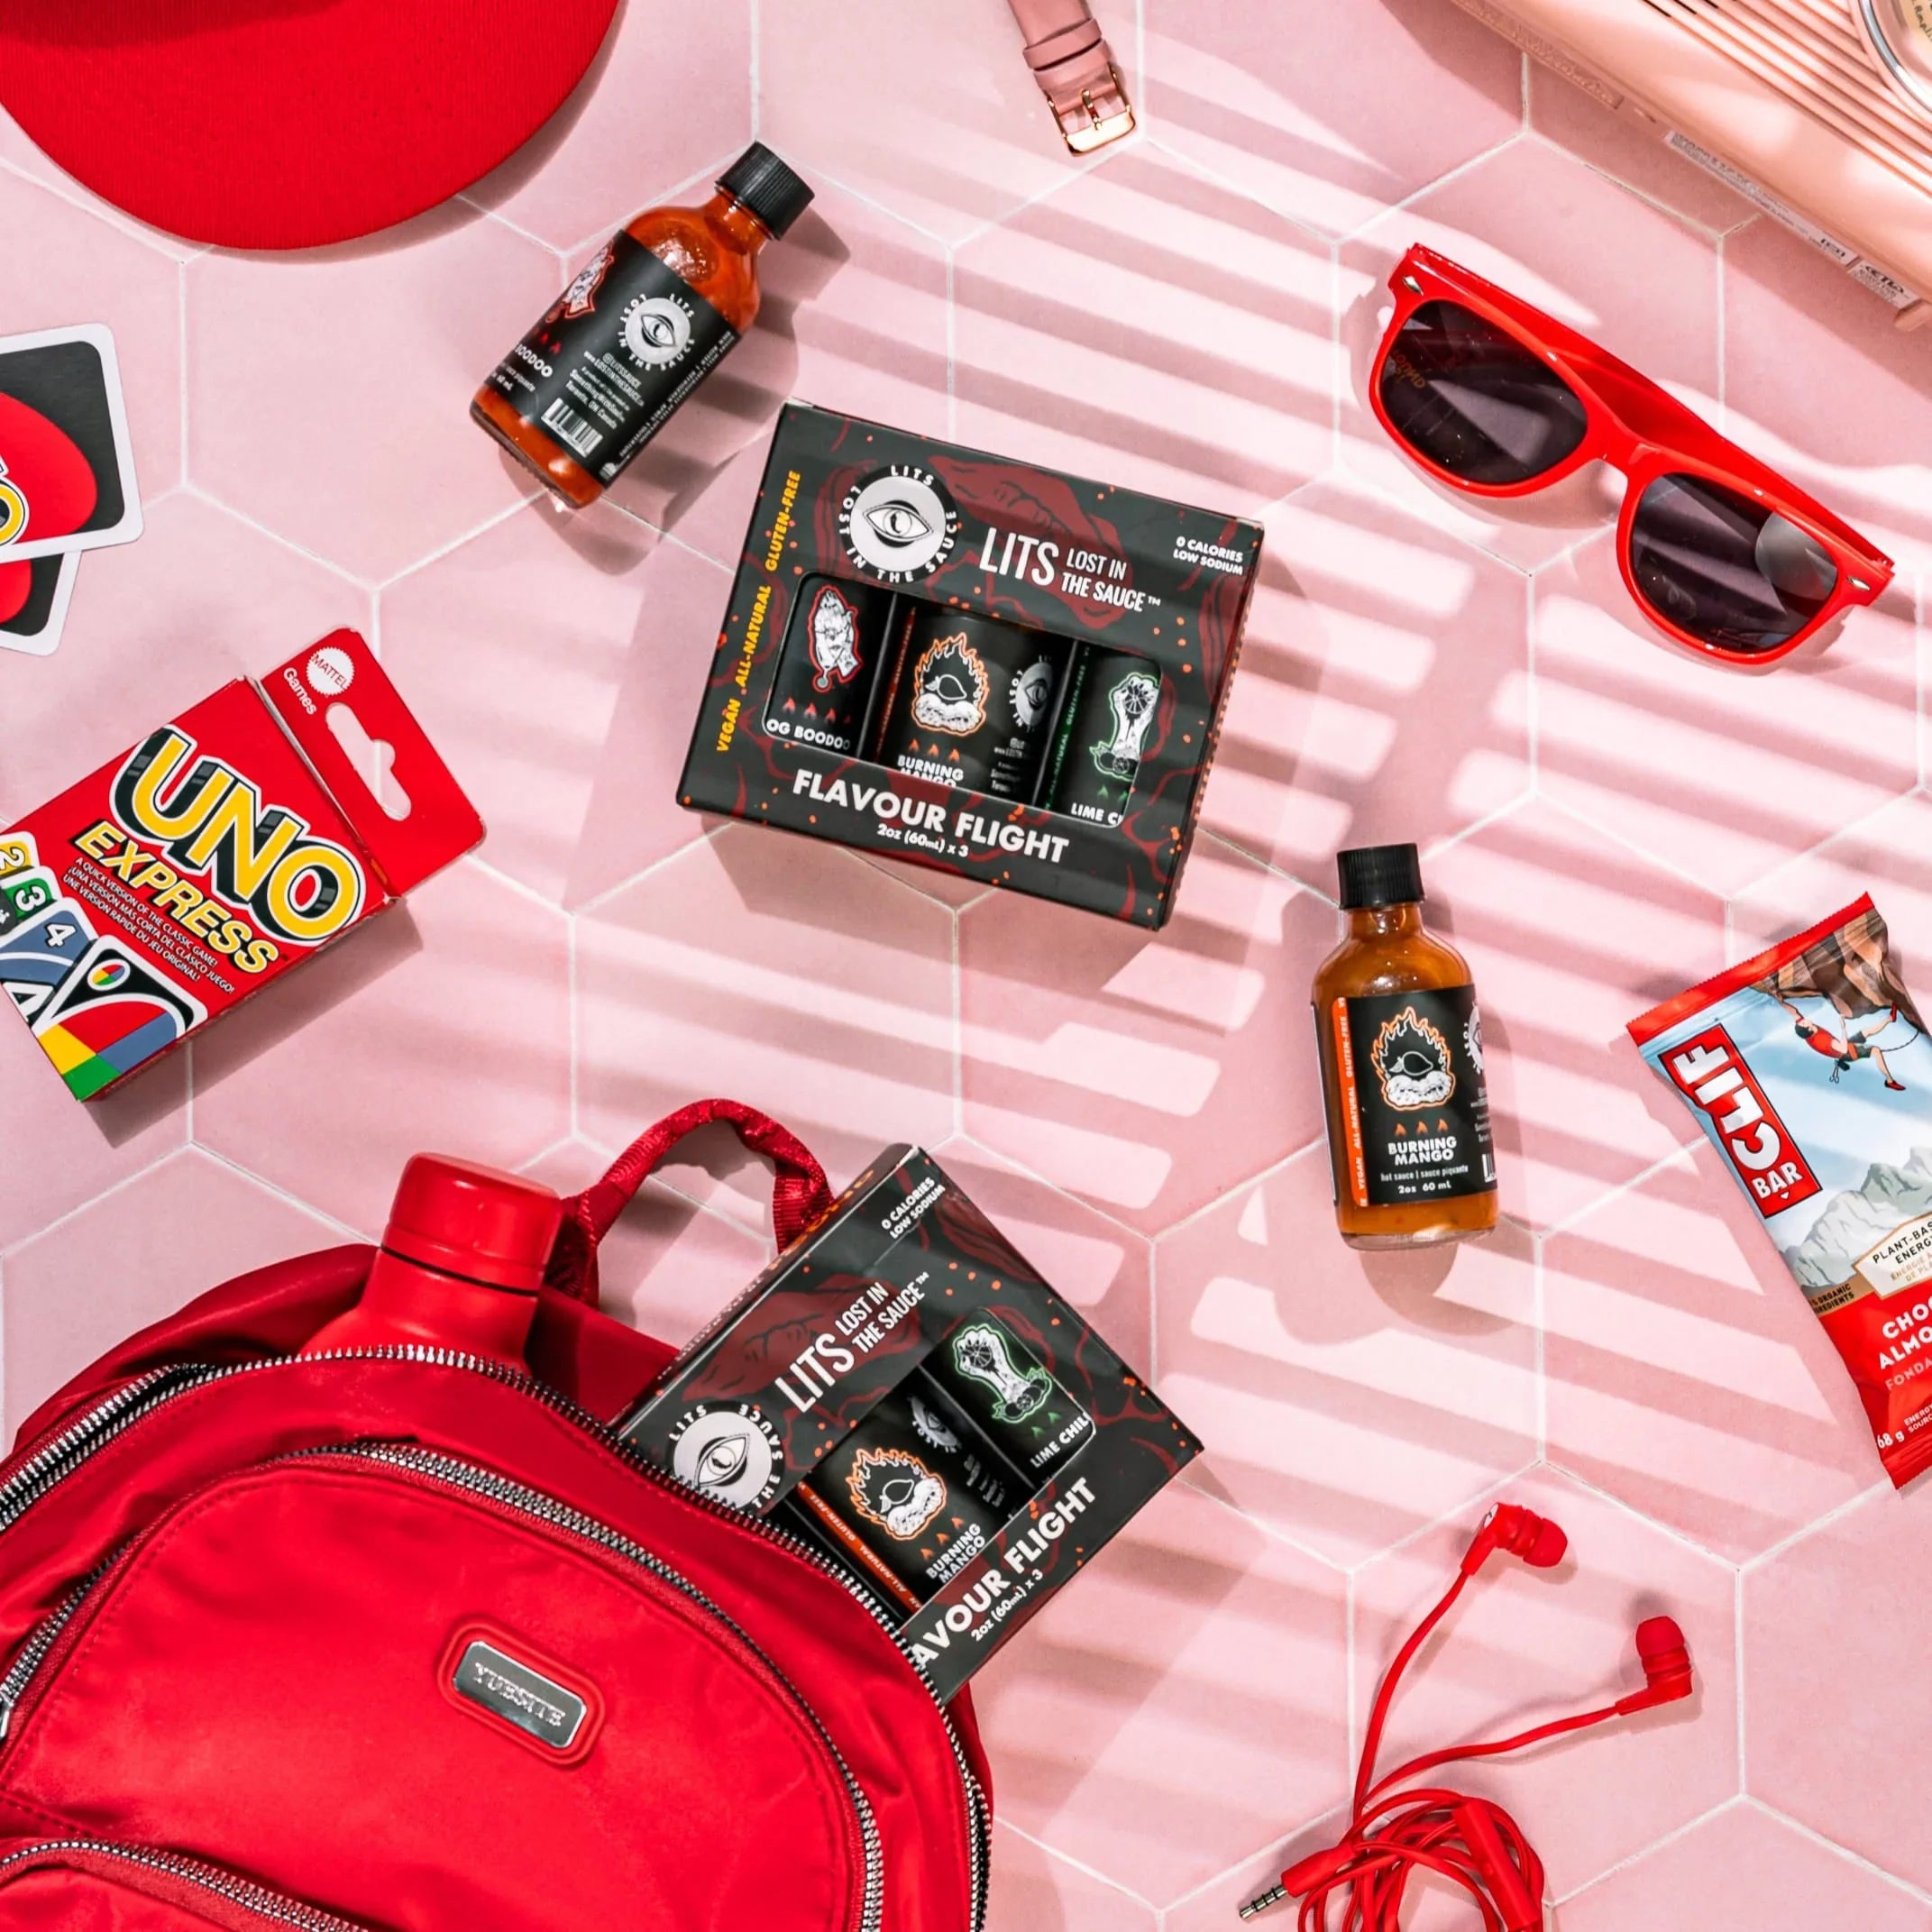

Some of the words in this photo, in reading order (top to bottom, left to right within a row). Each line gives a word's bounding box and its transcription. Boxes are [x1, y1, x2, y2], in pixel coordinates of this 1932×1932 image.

[620, 293, 645, 320] LOST
[669, 292, 694, 317] LITS
[618, 332, 627, 347] IN
[662, 339, 694, 371] SAUCE
[628, 353, 650, 371] THE
[891, 464, 934, 484] LITS
[838, 485, 861, 534] LOST
[846, 547, 865, 568] IN
[925, 511, 957, 572] SAUCE
[977, 527, 1061, 587] LITS
[1175, 536, 1186, 548] 0
[1186, 538, 1244, 563] CALORIES
[877, 570, 913, 582] THE
[1065, 547, 1107, 575] LOST
[1108, 559, 1127, 581] IN
[1172, 548, 1198, 563] LOW
[1199, 554, 1244, 575] SODIUM
[1058, 572, 1092, 598] THE
[716, 698, 741, 753] VEGAN
[734, 583, 772, 686] ALL-NATURAL
[764, 470, 801, 571] GLUTEN-FREE
[283, 667, 317, 714] Games
[311, 655, 345, 691] MATTEL
[765, 718, 792, 737] OG
[896, 754, 965, 783] BURNING
[792, 768, 948, 834] FLAVOUR
[953, 812, 1069, 863] FLIGHT
[1070, 802, 1103, 821] LIME
[114, 727, 365, 945] UNO
[876, 823, 902, 840] 2oz
[947, 845, 957, 856] x
[957, 845, 969, 859] 3
[15, 885, 47, 912] 3
[73, 821, 279, 974] EXPRESS
[75, 856, 85, 865] A
[81, 860, 108, 884] QUICK
[104, 878, 138, 907] VERSION
[135, 902, 149, 915] OF
[146, 910, 164, 927] THE
[160, 921, 194, 949] CLASSIC
[190, 944, 218, 967] GAME!
[46, 923, 77, 948] 4
[62, 873, 80, 889] UNE
[78, 885, 112, 913] VERSION
[109, 910, 138, 934] RAPIDE
[135, 929, 150, 943] DU
[147, 939, 163, 954] JEU
[160, 949, 200, 982] ORIGINAL!
[134, 915, 161, 939] CORTA
[160, 934, 177, 950] DEL
[205, 969, 234, 994] JUEGO!
[1340, 1016, 1352, 1077] GLUTEN-FREE
[1348, 1085, 1360, 1149] ALL-NATURAL
[1671, 1045, 1779, 1169] CLIF
[1387, 1135, 1457, 1155] BURNING
[1394, 1149, 1454, 1166] MANGO
[1380, 1172, 1392, 1181] hot
[1393, 1171, 1414, 1180] sauce
[1420, 1168, 1440, 1177] sauce
[1397, 1185, 1416, 1194] 2oz
[1422, 1181, 1435, 1191] 60
[1751, 1158, 1803, 1199] BAR
[880, 1217, 893, 1231] 0
[887, 1175, 937, 1222] CALORIES
[888, 1216, 911, 1241] LOW
[909, 1183, 946, 1220] SODIUM
[1895, 1235, 1932, 1264] ENERG
[833, 1294, 875, 1338] LOST
[865, 1281, 890, 1305] IN
[1818, 1282, 1851, 1304] ORGANIC
[851, 1320, 886, 1356] THE
[774, 1328, 859, 1414] LITS
[669, 1405, 707, 1441] LITS
[738, 1403, 782, 1458] SAUCE
[1877, 1433, 1894, 1450] 68
[1895, 1430, 1905, 1442] g
[1029, 1440, 1061, 1469] LIME
[751, 1475, 780, 1507] THE
[1003, 1476, 1097, 1575] FLIGHT
[925, 1522, 982, 1579] BURNING
[938, 1534, 987, 1583] MANGO
[969, 1617, 995, 1642] 2oz
[1024, 1579, 1035, 1589] x
[1030, 1567, 1044, 1580] 3
